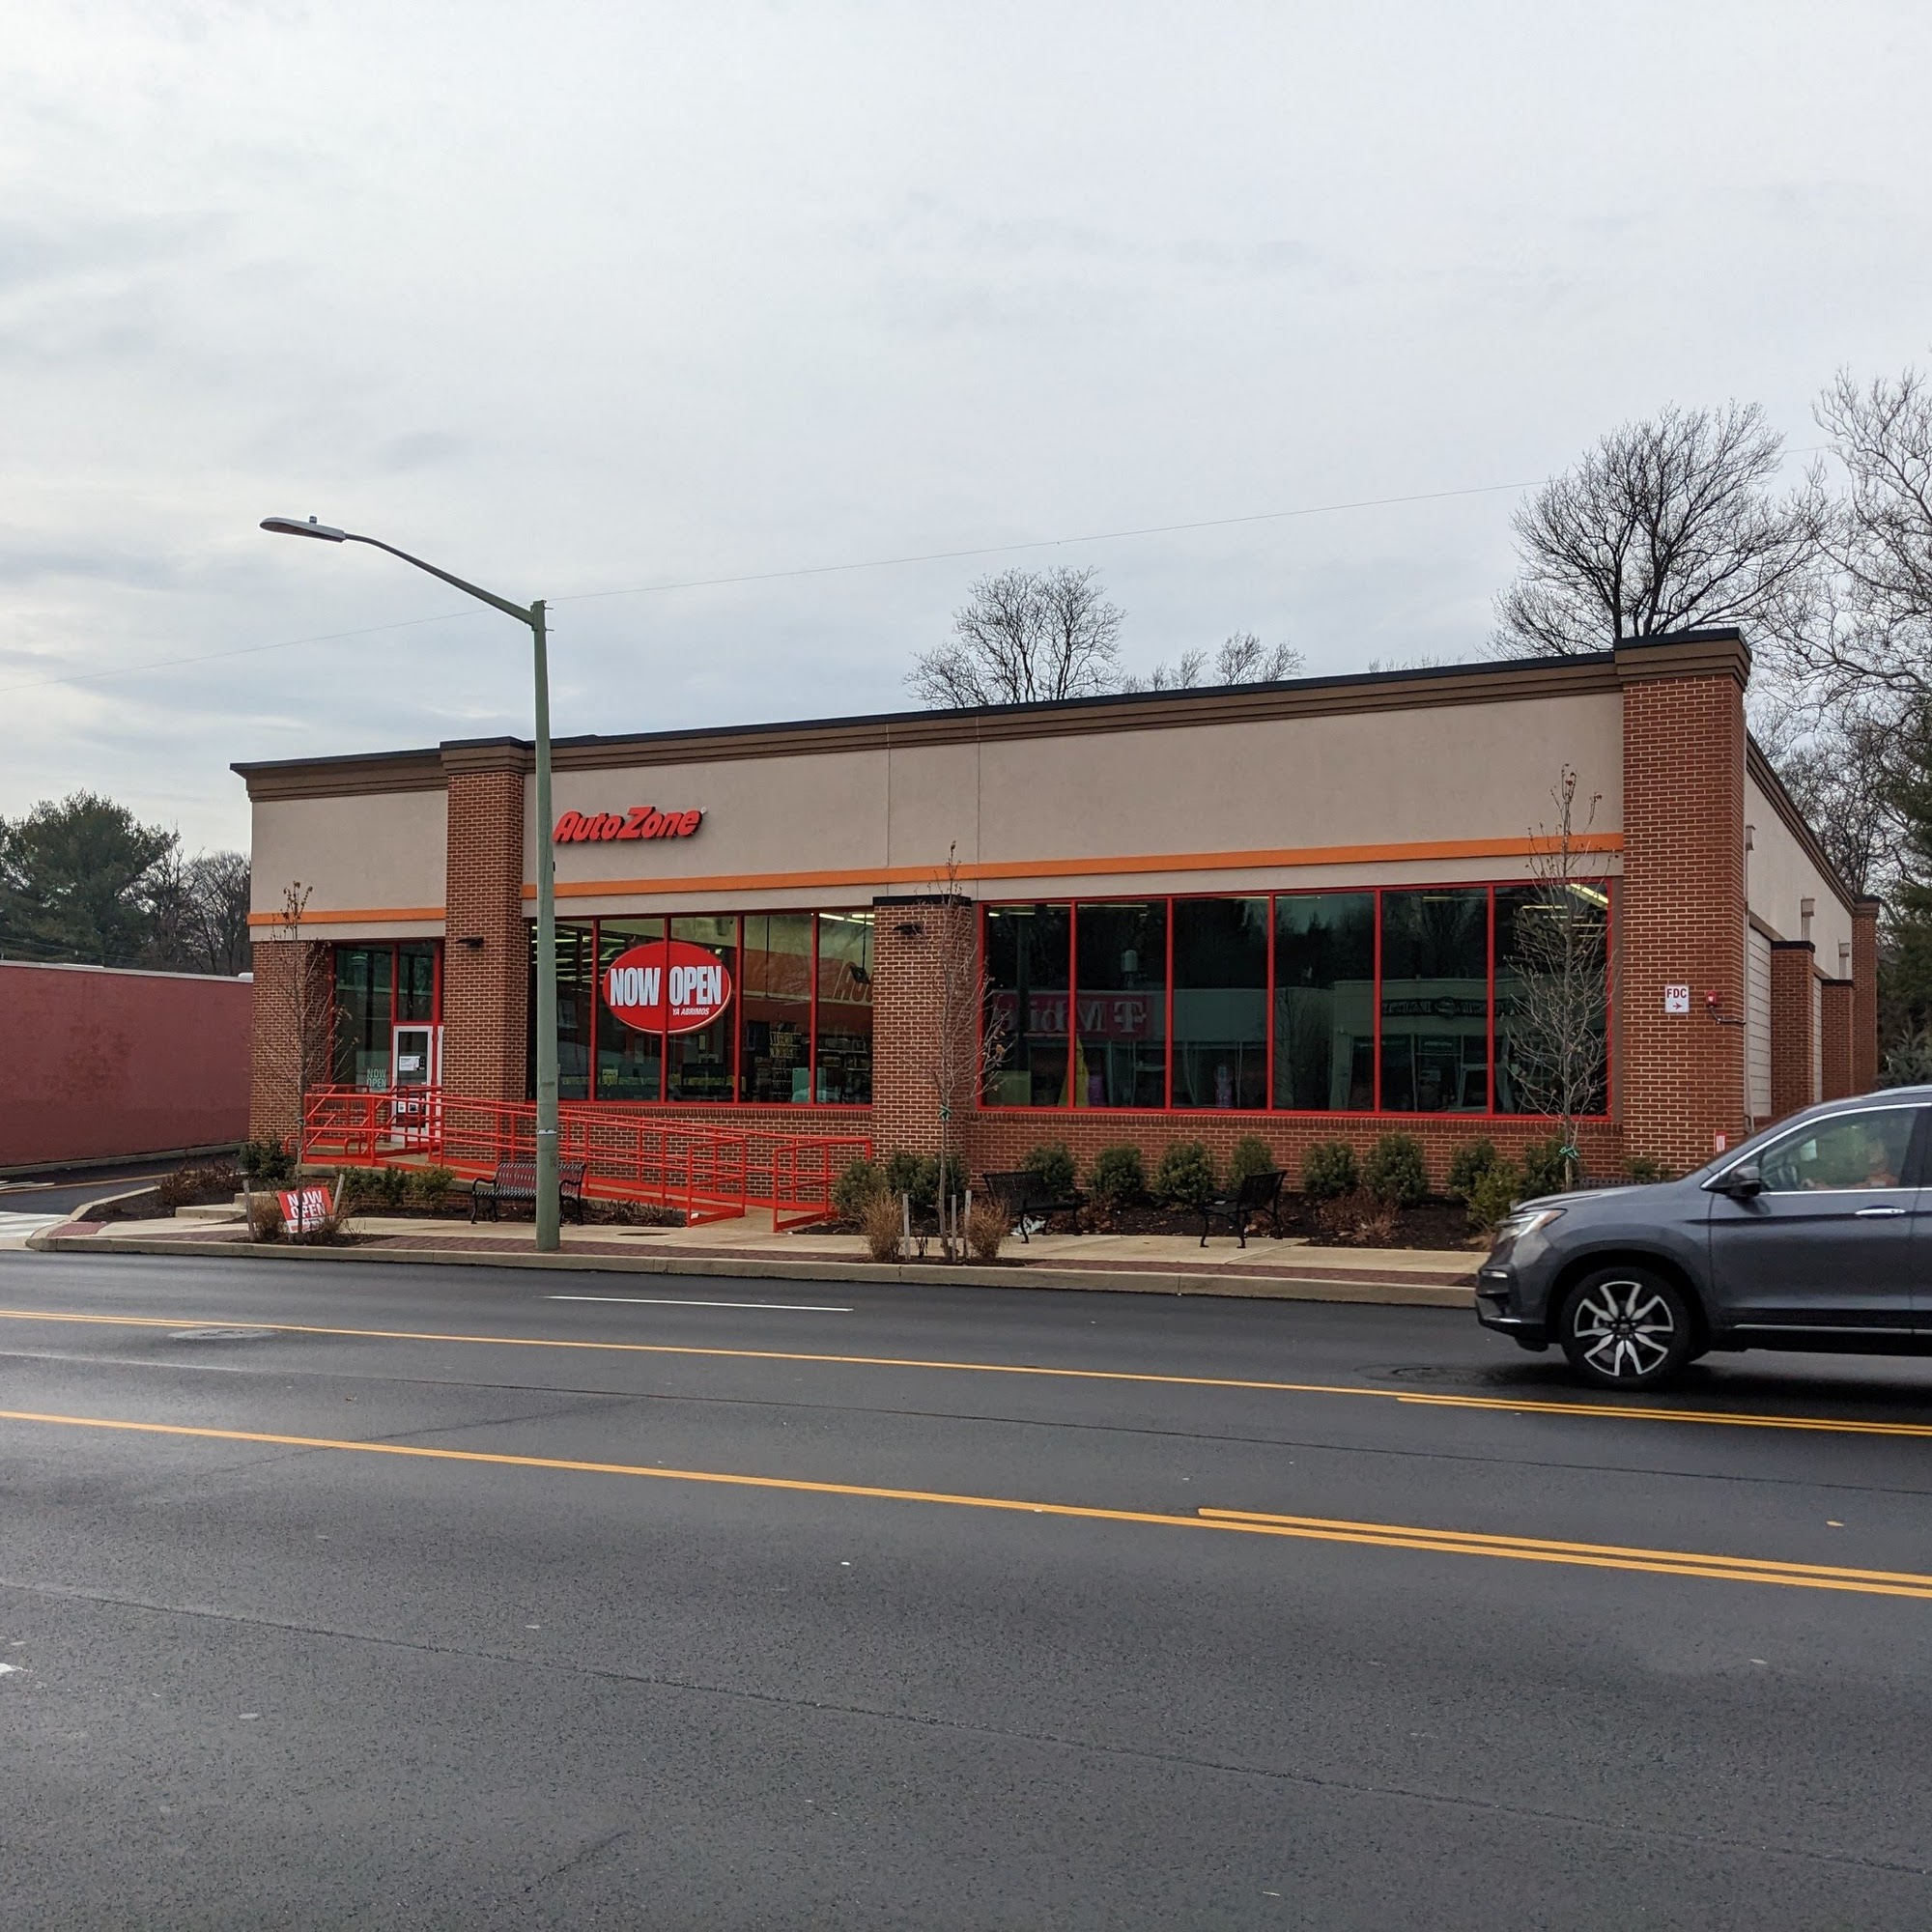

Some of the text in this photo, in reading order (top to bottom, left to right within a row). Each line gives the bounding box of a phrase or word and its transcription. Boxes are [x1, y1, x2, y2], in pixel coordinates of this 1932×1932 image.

[552, 806, 702, 841] AutoZone
[610, 966, 722, 1007] NOW OPEN
[1666, 988, 1687, 998] FDC
[672, 1008, 710, 1016] YA ABRIMOS
[367, 1068, 386, 1078] NOW
[367, 1078, 386, 1087] OPEN
[291, 1203, 326, 1218] OPEN
